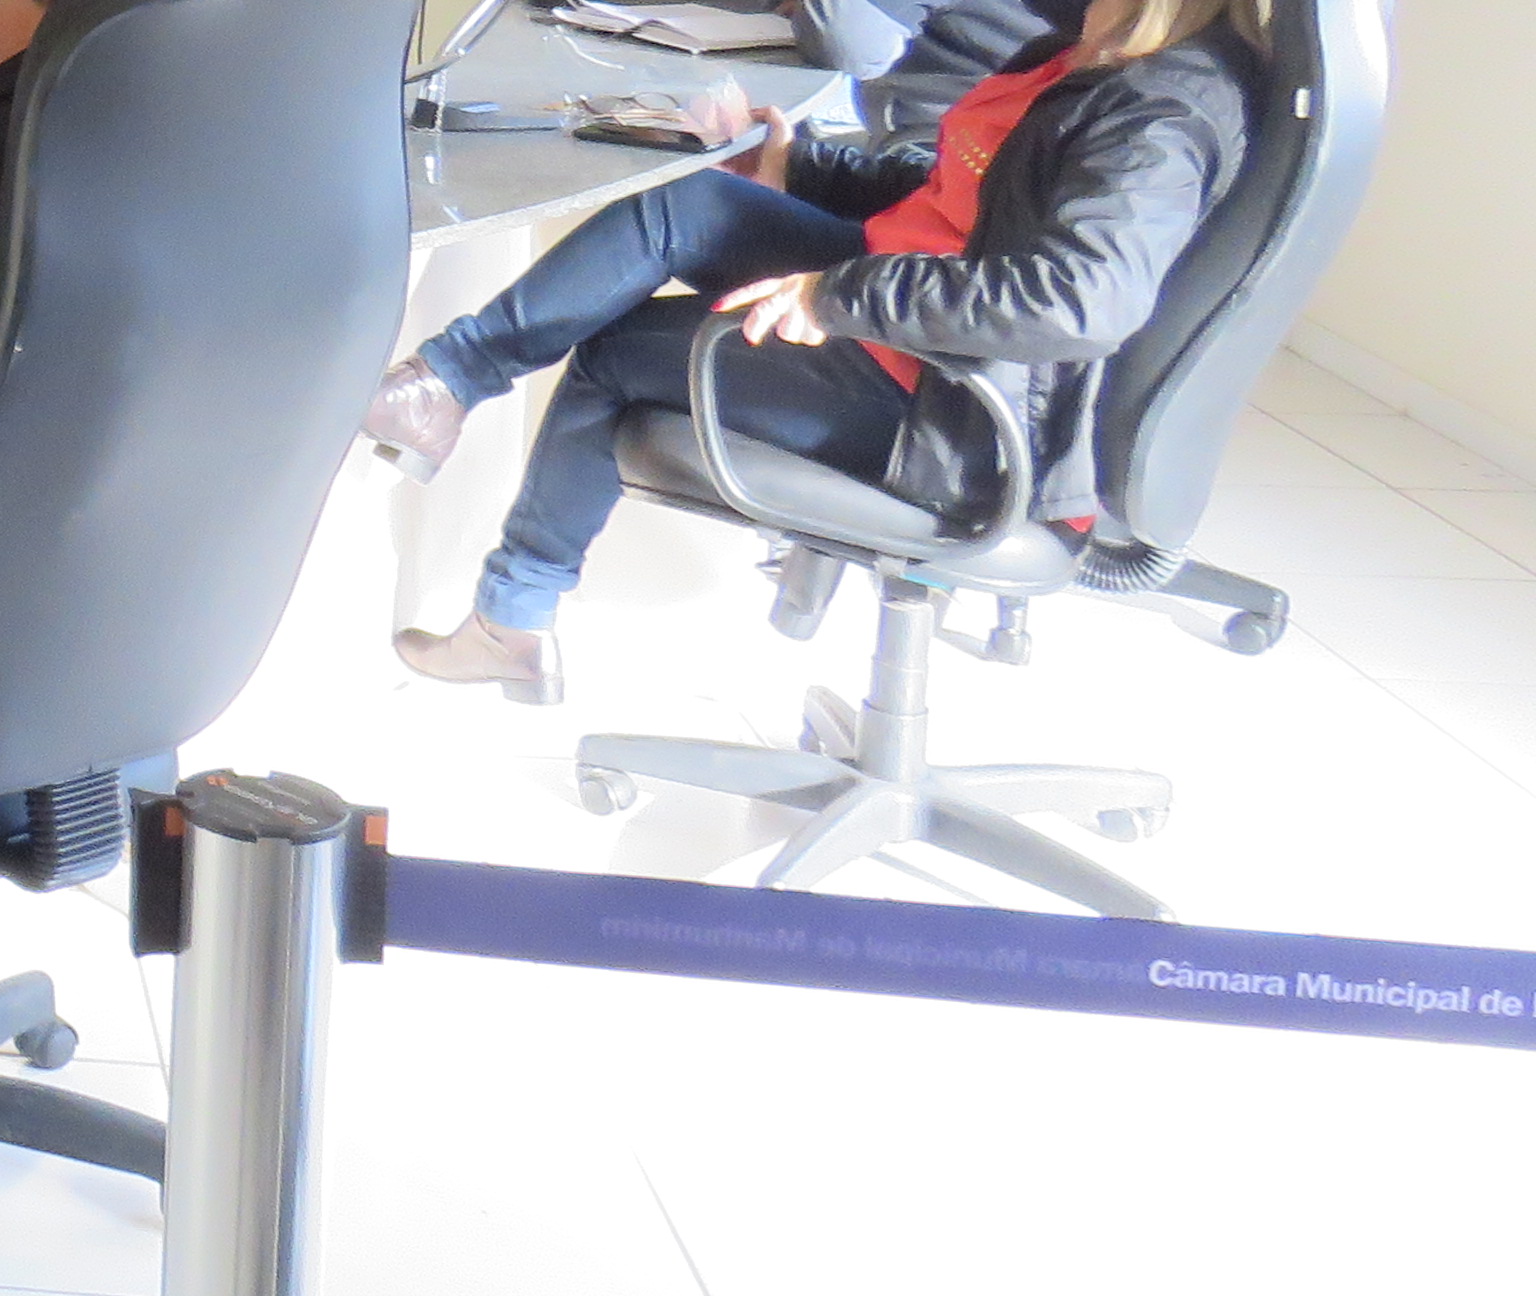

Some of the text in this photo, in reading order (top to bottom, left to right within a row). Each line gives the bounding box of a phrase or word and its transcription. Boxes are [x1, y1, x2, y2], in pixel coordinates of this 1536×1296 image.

[1147, 958, 1286, 997] Câmara
[1295, 971, 1470, 1014] Municipal
[1478, 988, 1525, 1018] de
